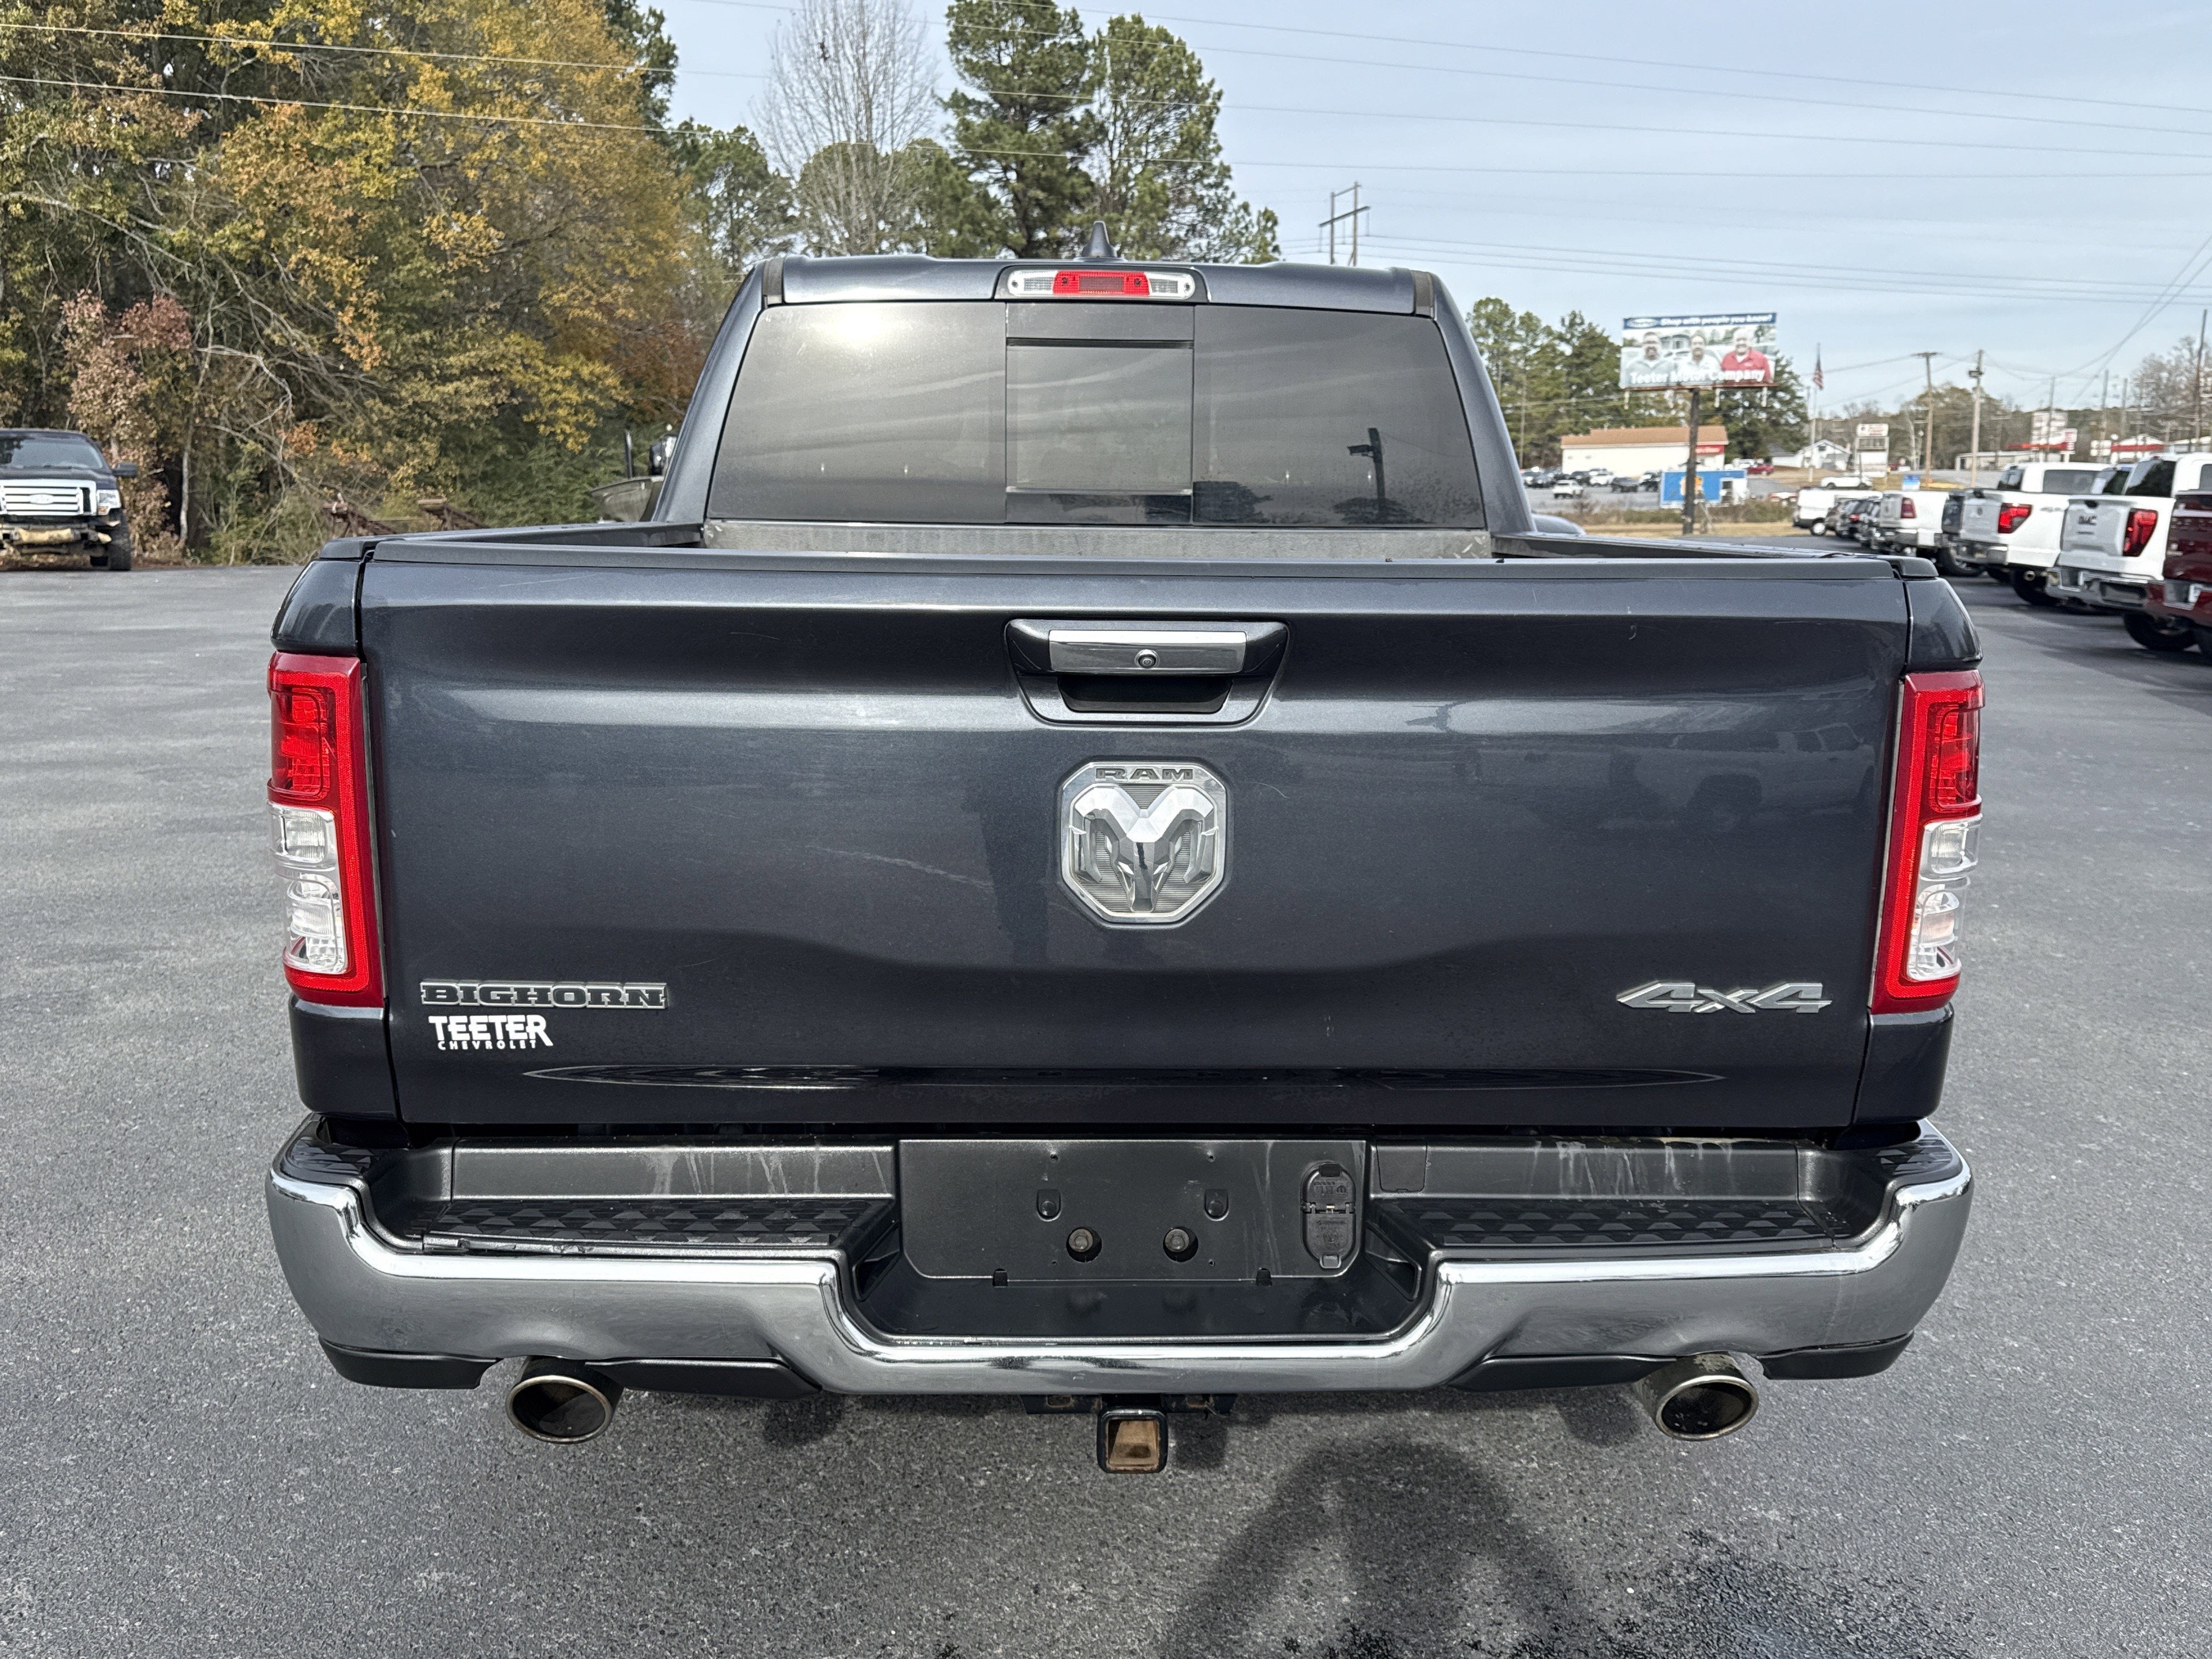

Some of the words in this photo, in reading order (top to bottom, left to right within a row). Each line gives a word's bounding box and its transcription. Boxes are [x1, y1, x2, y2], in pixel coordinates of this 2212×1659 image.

[1660, 318, 1681, 328] Shop
[1630, 372, 1668, 384] Teeter
[1671, 370, 1706, 382] Motor
[1709, 369, 1765, 382] Company
[1095, 768, 1194, 781] RAM
[420, 981, 668, 1009] BIGHORN
[428, 1015, 554, 1046] TEETER
[437, 1040, 538, 1051] CHEVROLET
